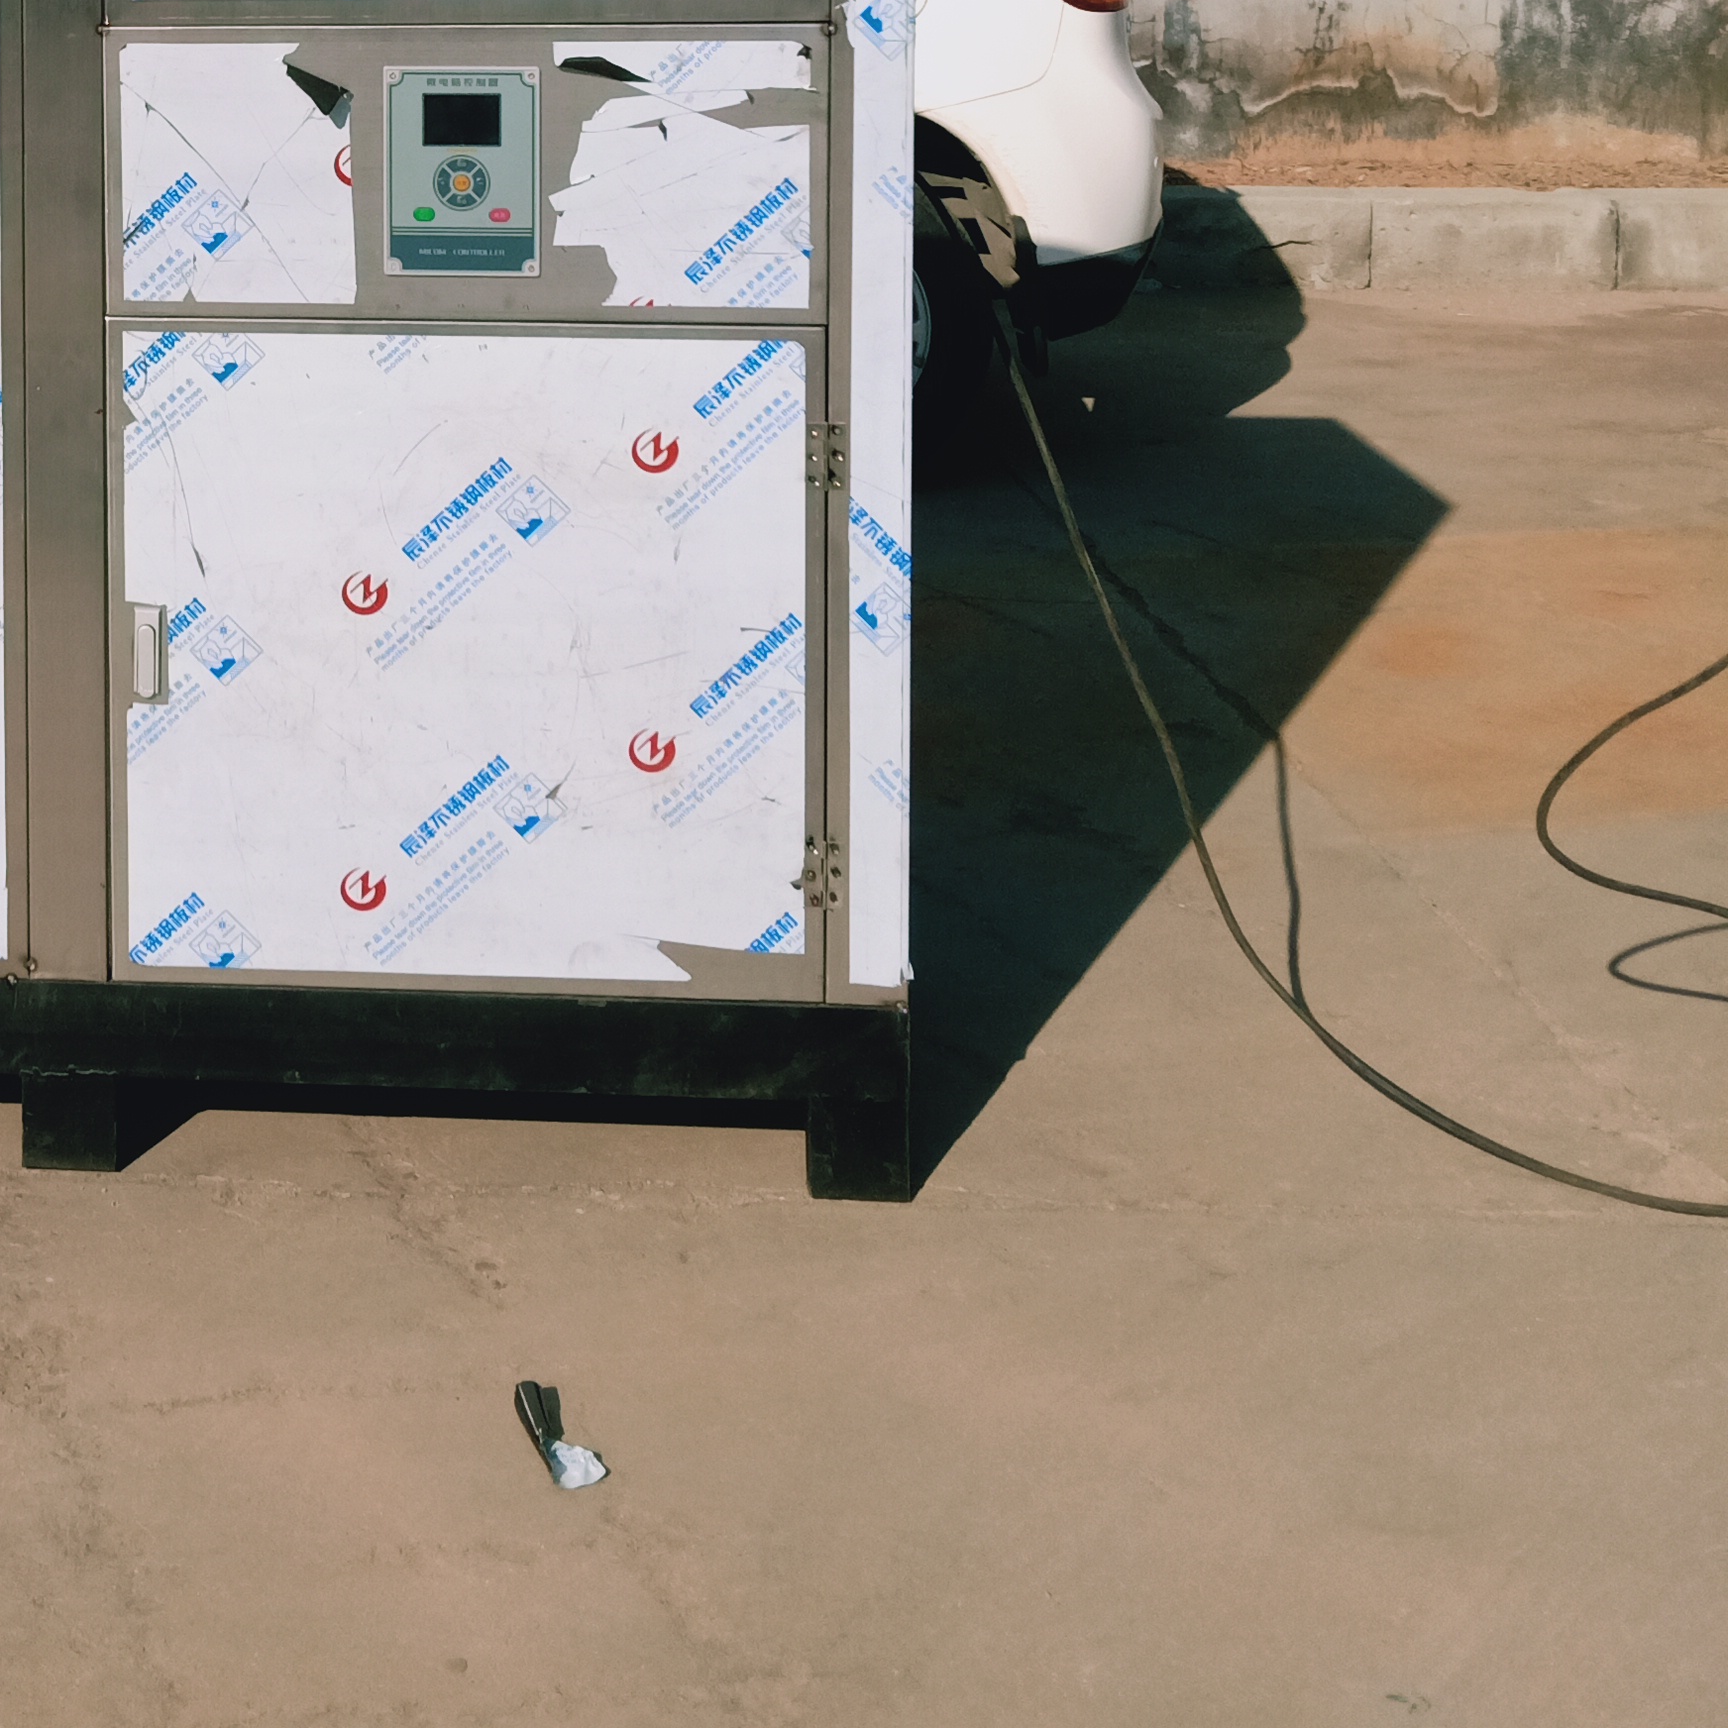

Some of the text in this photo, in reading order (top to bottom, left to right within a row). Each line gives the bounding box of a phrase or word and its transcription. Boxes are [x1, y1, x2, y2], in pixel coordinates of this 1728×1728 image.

[122, 172, 198, 258] 不锈钢板材
[683, 177, 798, 285] 辰泽不锈钢板材
[123, 330, 192, 393] 泽不锈钢
[401, 457, 512, 561] 辰泽不锈钢板材
[850, 501, 913, 583] 泽不锈钢
[689, 612, 802, 718] 辰泽不锈钢板材
[399, 754, 509, 857] 辰泽不锈钢板材
